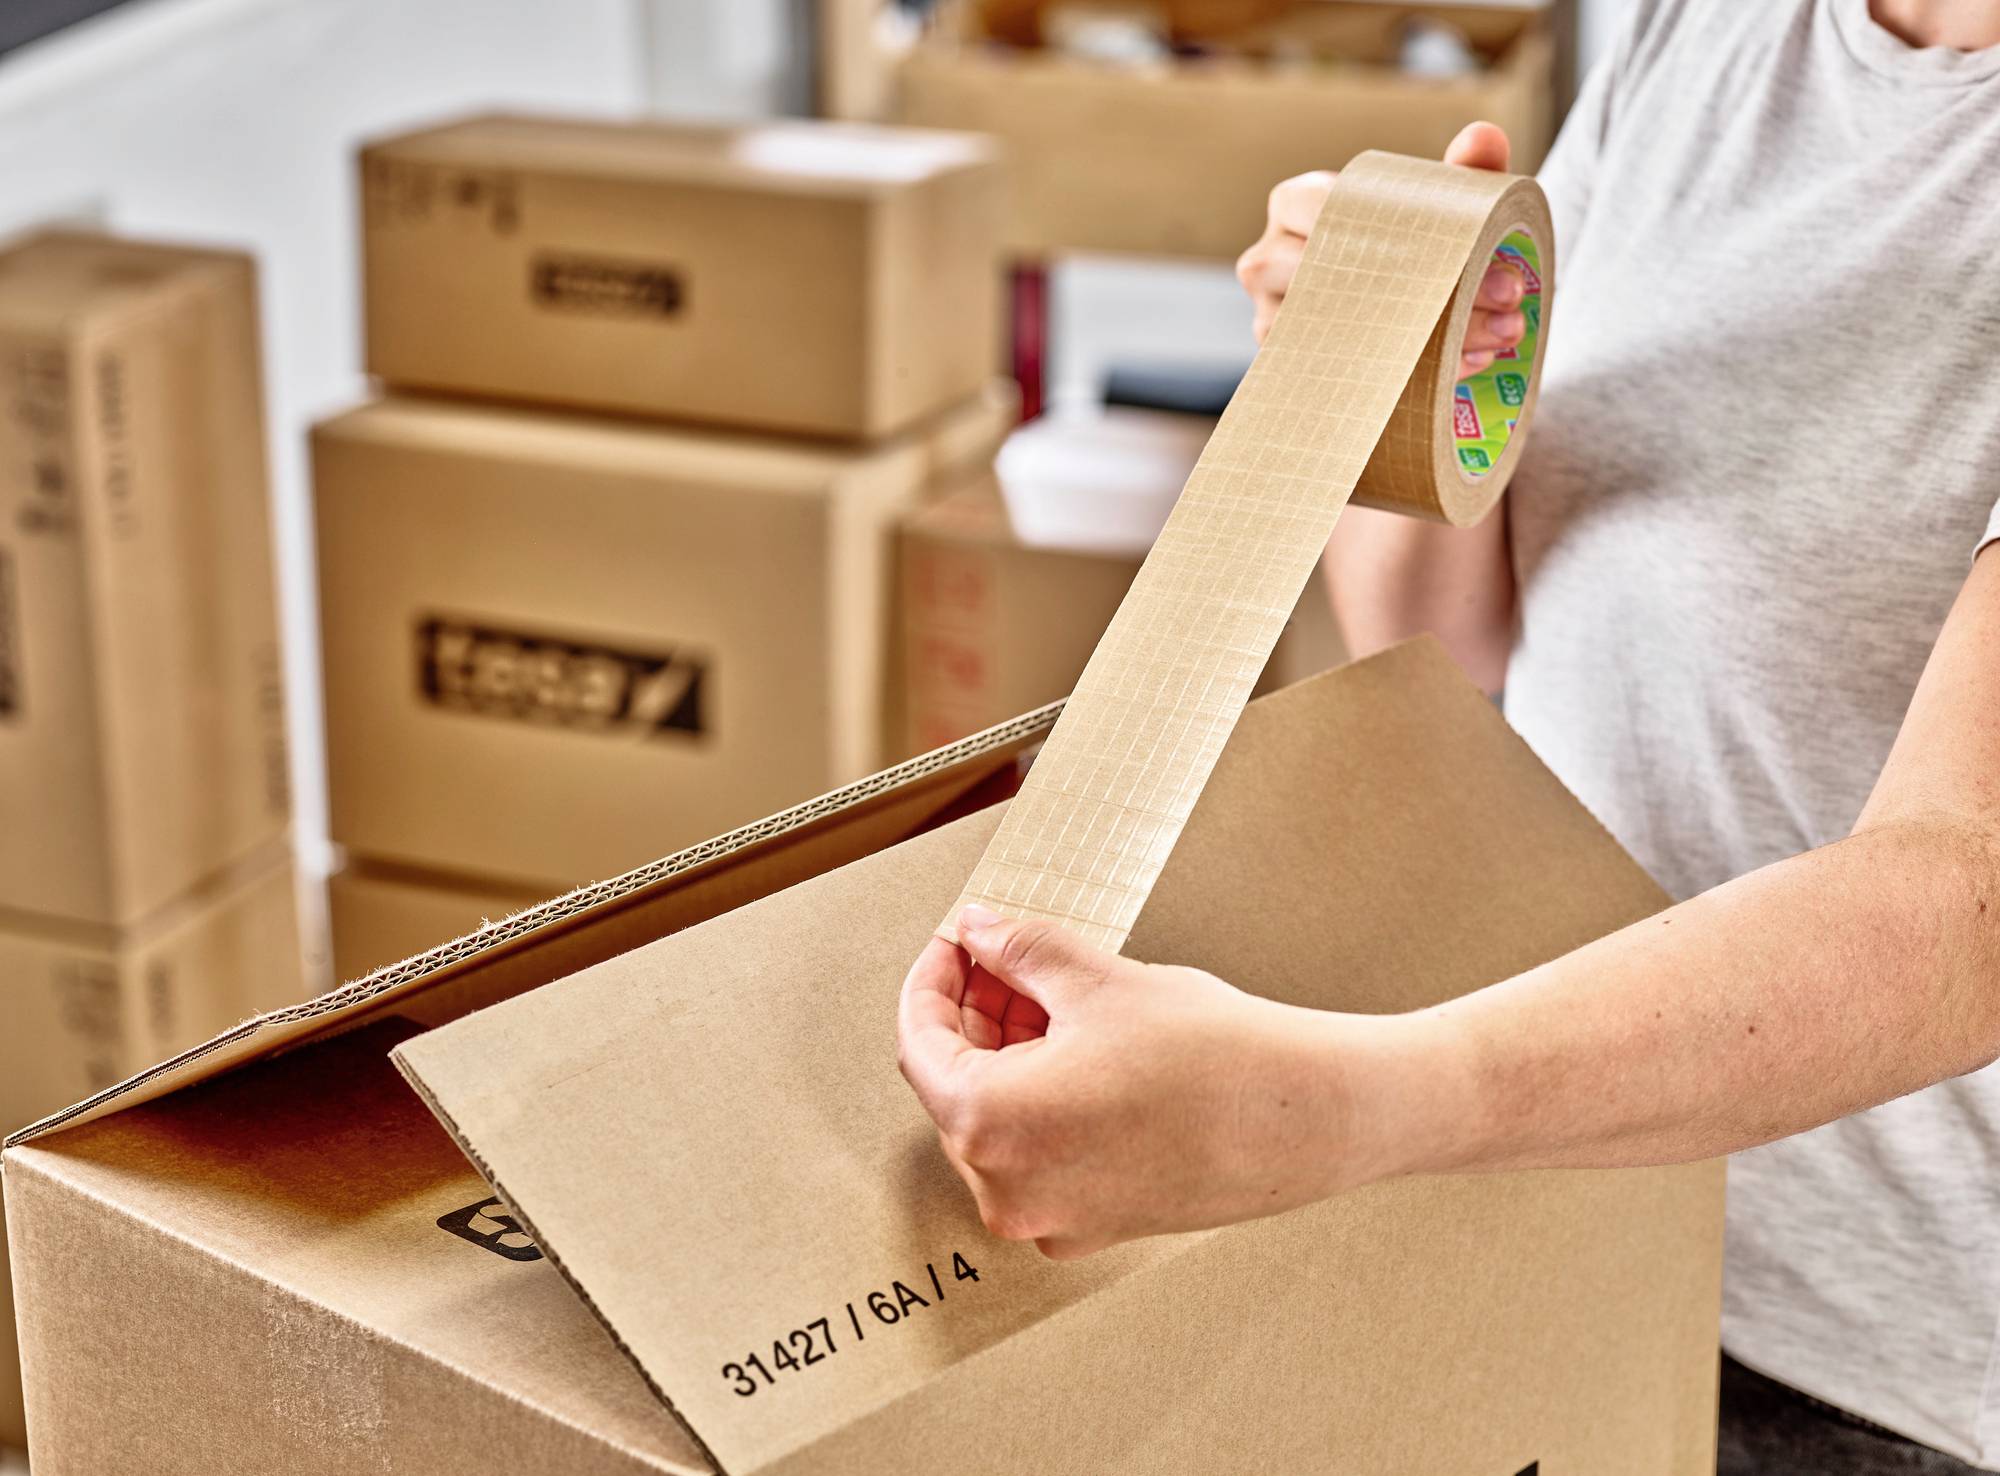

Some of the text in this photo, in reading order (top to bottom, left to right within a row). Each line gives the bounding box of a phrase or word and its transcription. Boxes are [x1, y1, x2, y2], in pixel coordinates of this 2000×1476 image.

[721, 1316, 838, 1397] 31427
[867, 1280, 931, 1325] 6A
[953, 1252, 980, 1282] 4
